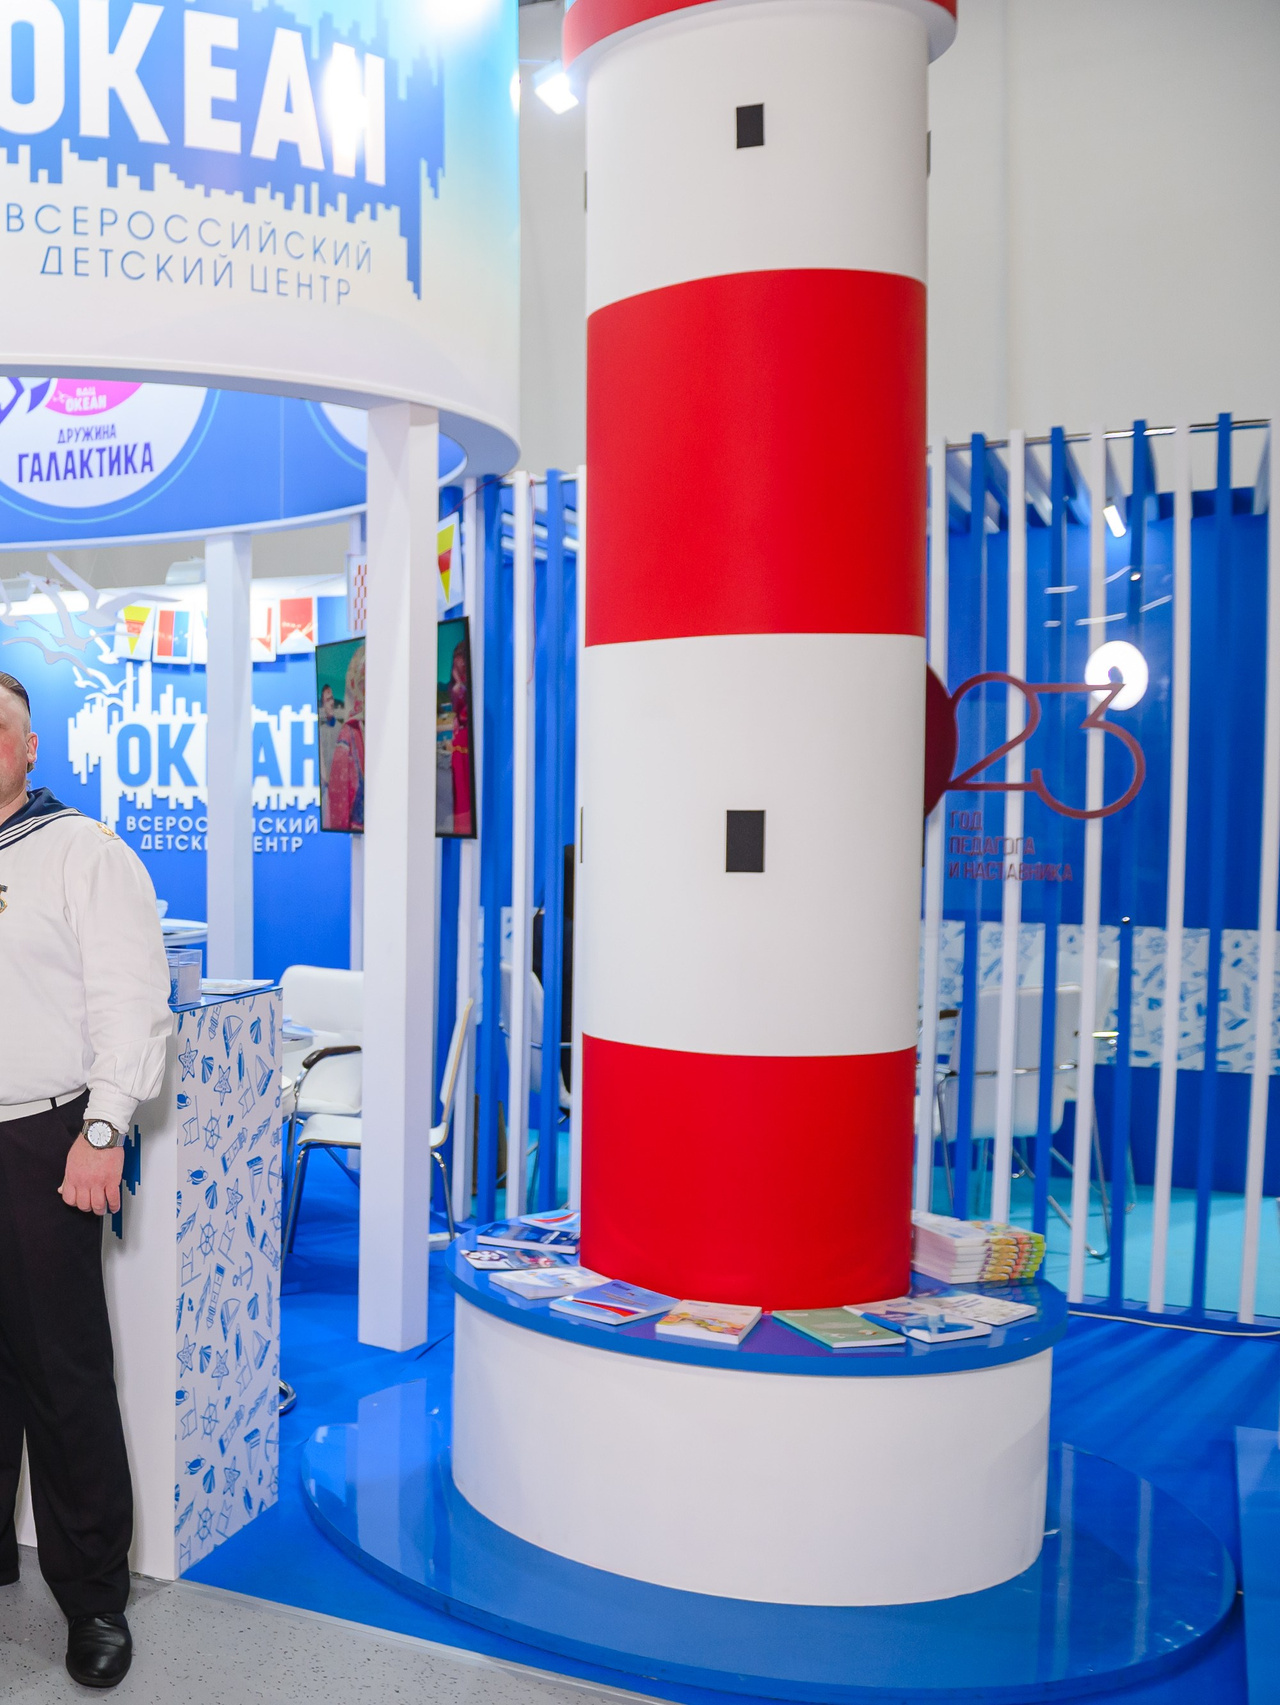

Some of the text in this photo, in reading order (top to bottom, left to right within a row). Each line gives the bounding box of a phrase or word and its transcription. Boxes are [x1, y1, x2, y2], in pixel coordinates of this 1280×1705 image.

[5, 202, 372, 274] ВСЕРОССИЙСКИЙ
[39, 245, 351, 305] ДЕТСКИЙ ЦЕНТР
[65, 395, 108, 413] ОКЕАН
[57, 423, 118, 444] ДРУЖИНА
[18, 442, 154, 483] ГАЛАКТИКА
[117, 722, 319, 788] ОКАН
[949, 810, 983, 831] ГОД
[253, 836, 304, 854] ЕНТР
[949, 836, 1035, 857] ПЕДАГОГА
[949, 862, 1073, 882] И НАСТАВНИКА
